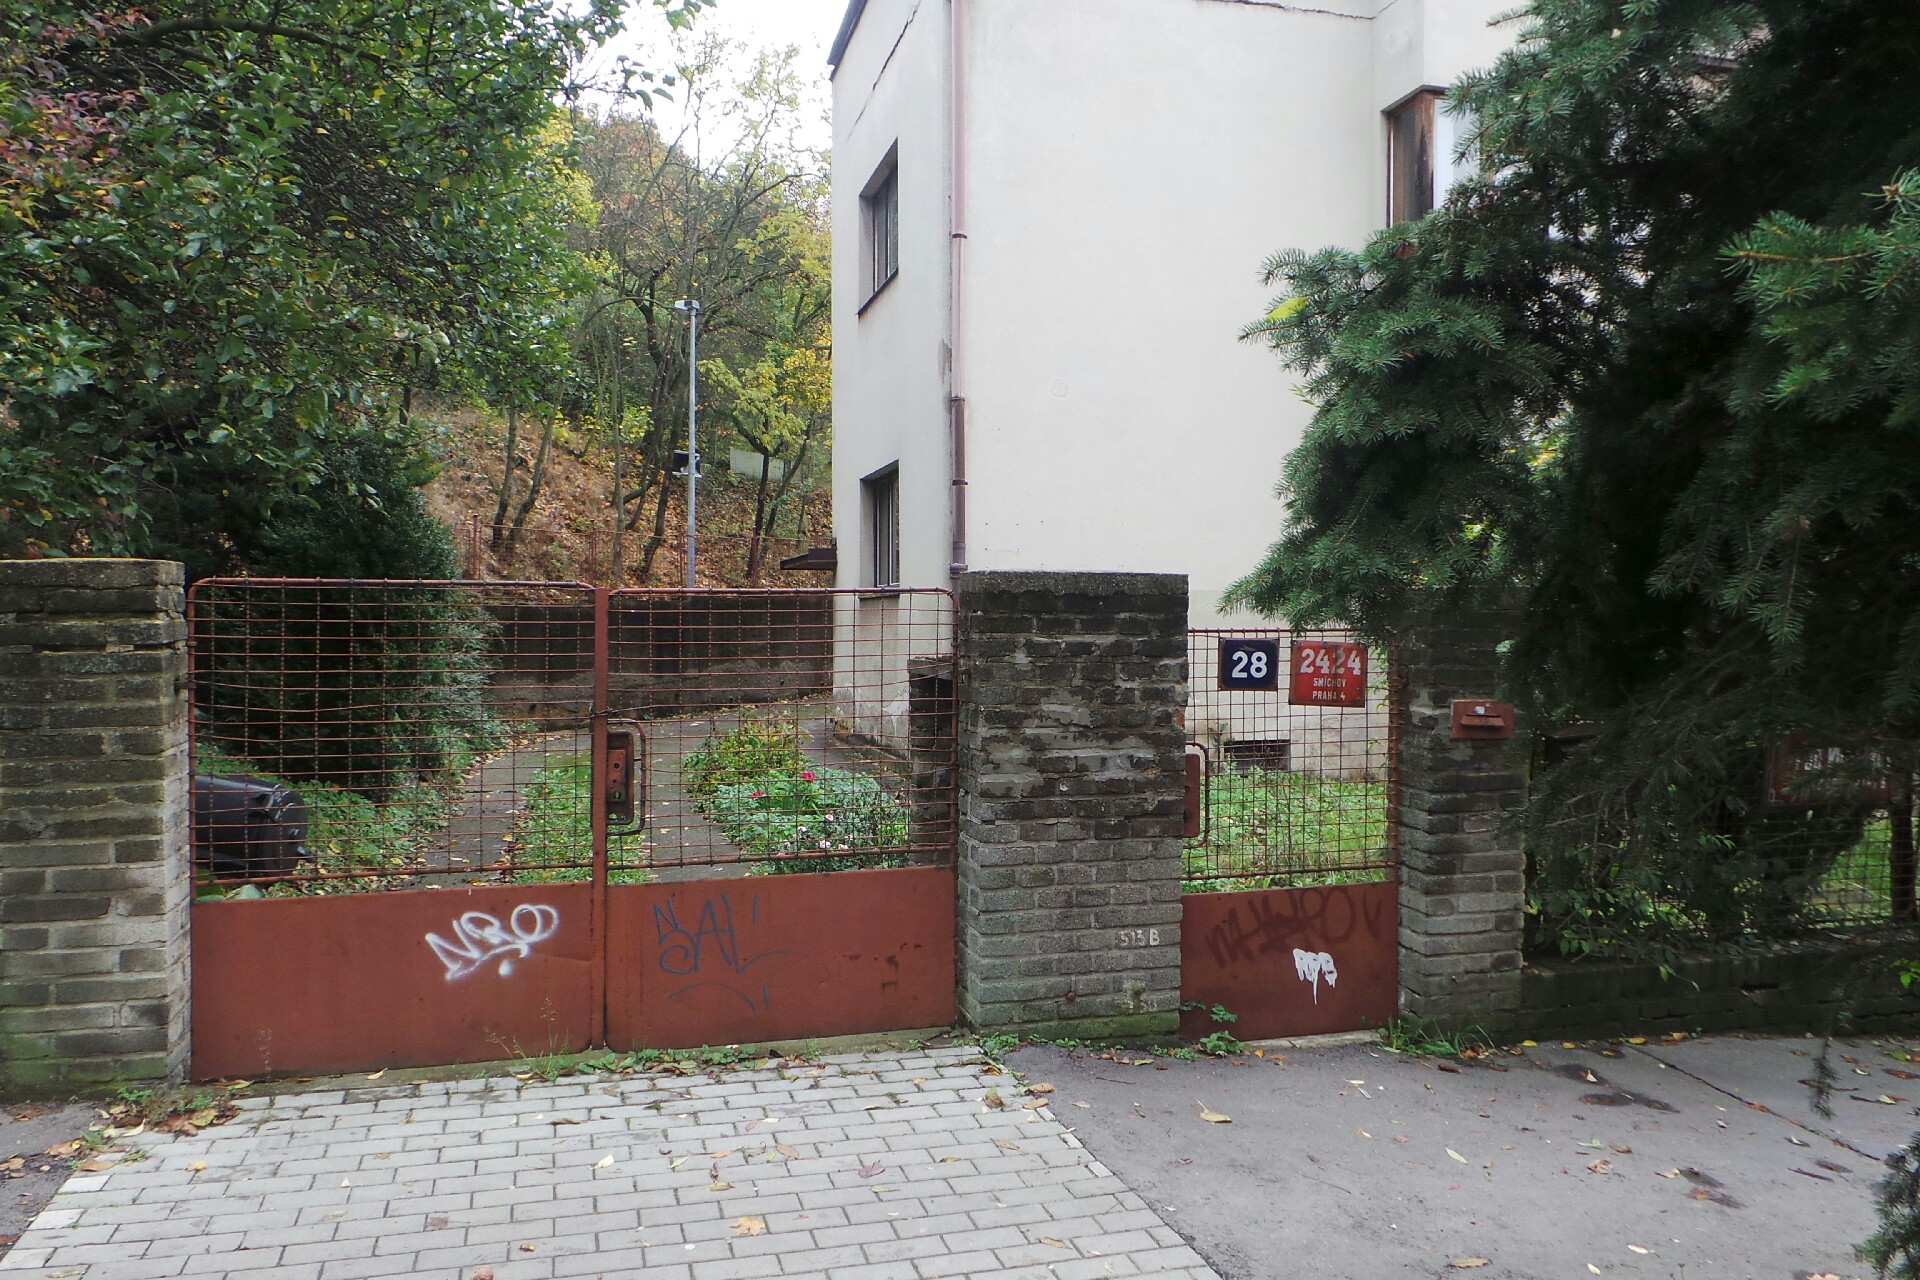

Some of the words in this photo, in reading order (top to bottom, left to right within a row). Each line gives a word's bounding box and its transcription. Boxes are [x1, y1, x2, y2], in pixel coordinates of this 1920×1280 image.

[1231, 651, 1268, 679] 28
[1299, 648, 1362, 676] 2424
[1313, 675, 1347, 688] SMÍCHOV
[1312, 690, 1337, 700] PRAHA
